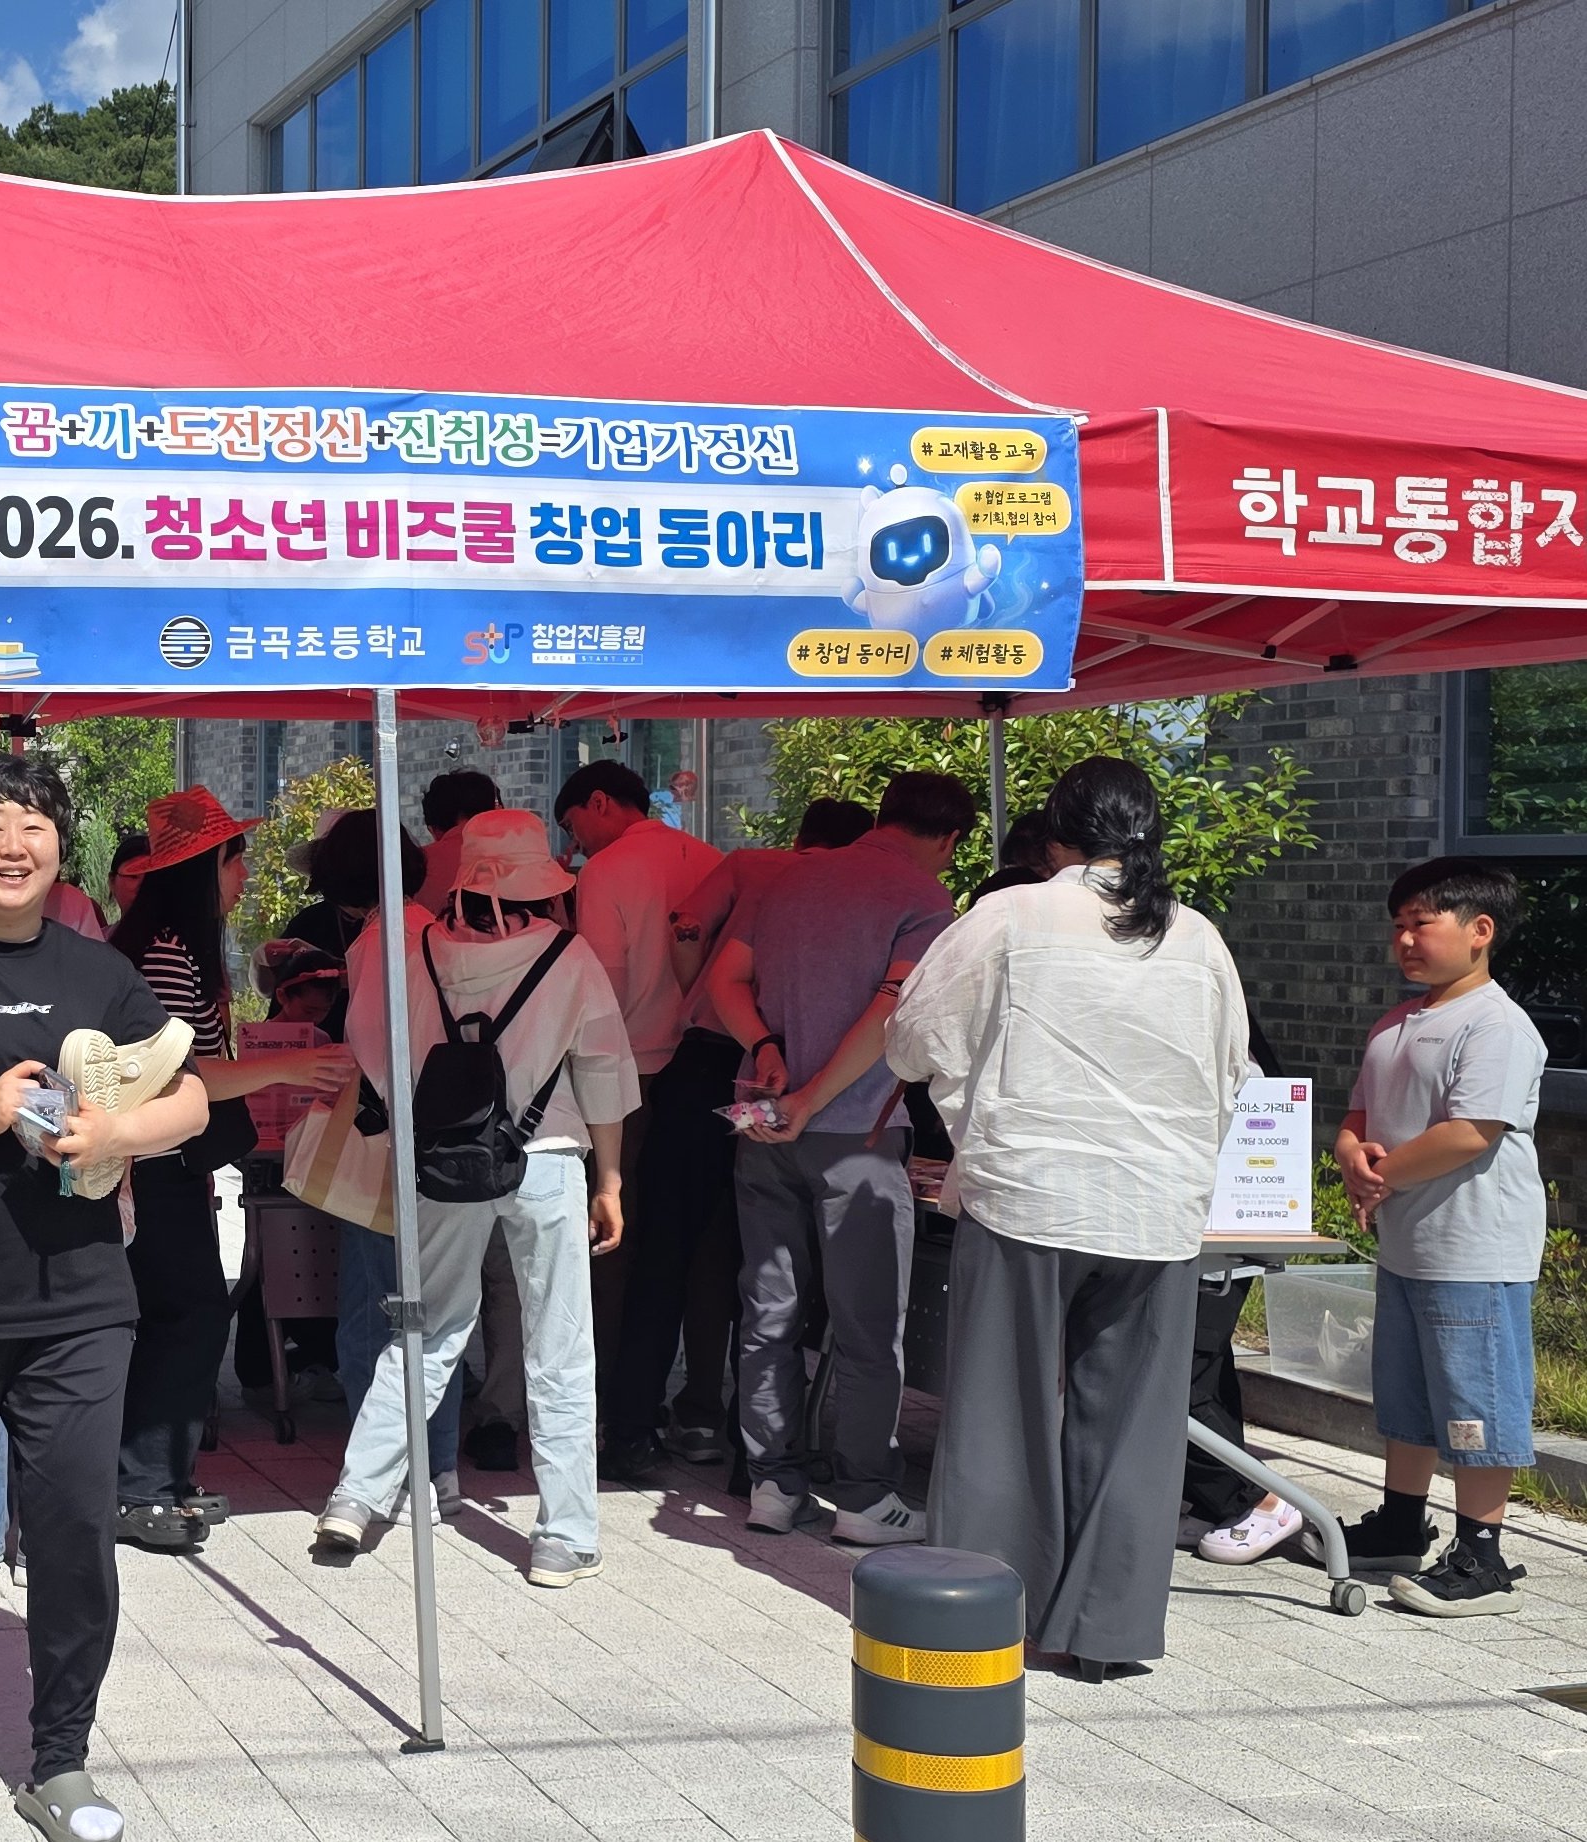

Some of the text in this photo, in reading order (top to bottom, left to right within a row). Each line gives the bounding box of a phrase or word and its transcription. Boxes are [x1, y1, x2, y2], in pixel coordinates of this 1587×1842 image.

[1005, 443, 1037, 460] 교육
[1033, 512, 1056, 526] 참여
[1232, 468, 1584, 567] 학교통합
[145, 496, 327, 561] 청소년
[345, 499, 516, 563] 비즈쿨
[529, 503, 643, 567] 창업
[657, 509, 824, 570] 동아리
[226, 625, 425, 660] 금곡초등학교
[532, 623, 646, 651] 창업진흥원
[815, 643, 850, 664] 창업
[856, 644, 910, 664] 동아리
[1263, 1102, 1295, 1113] 가격표
[1258, 1138, 1289, 1146] 3,000원
[1256, 1176, 1285, 1184] 1,000원
